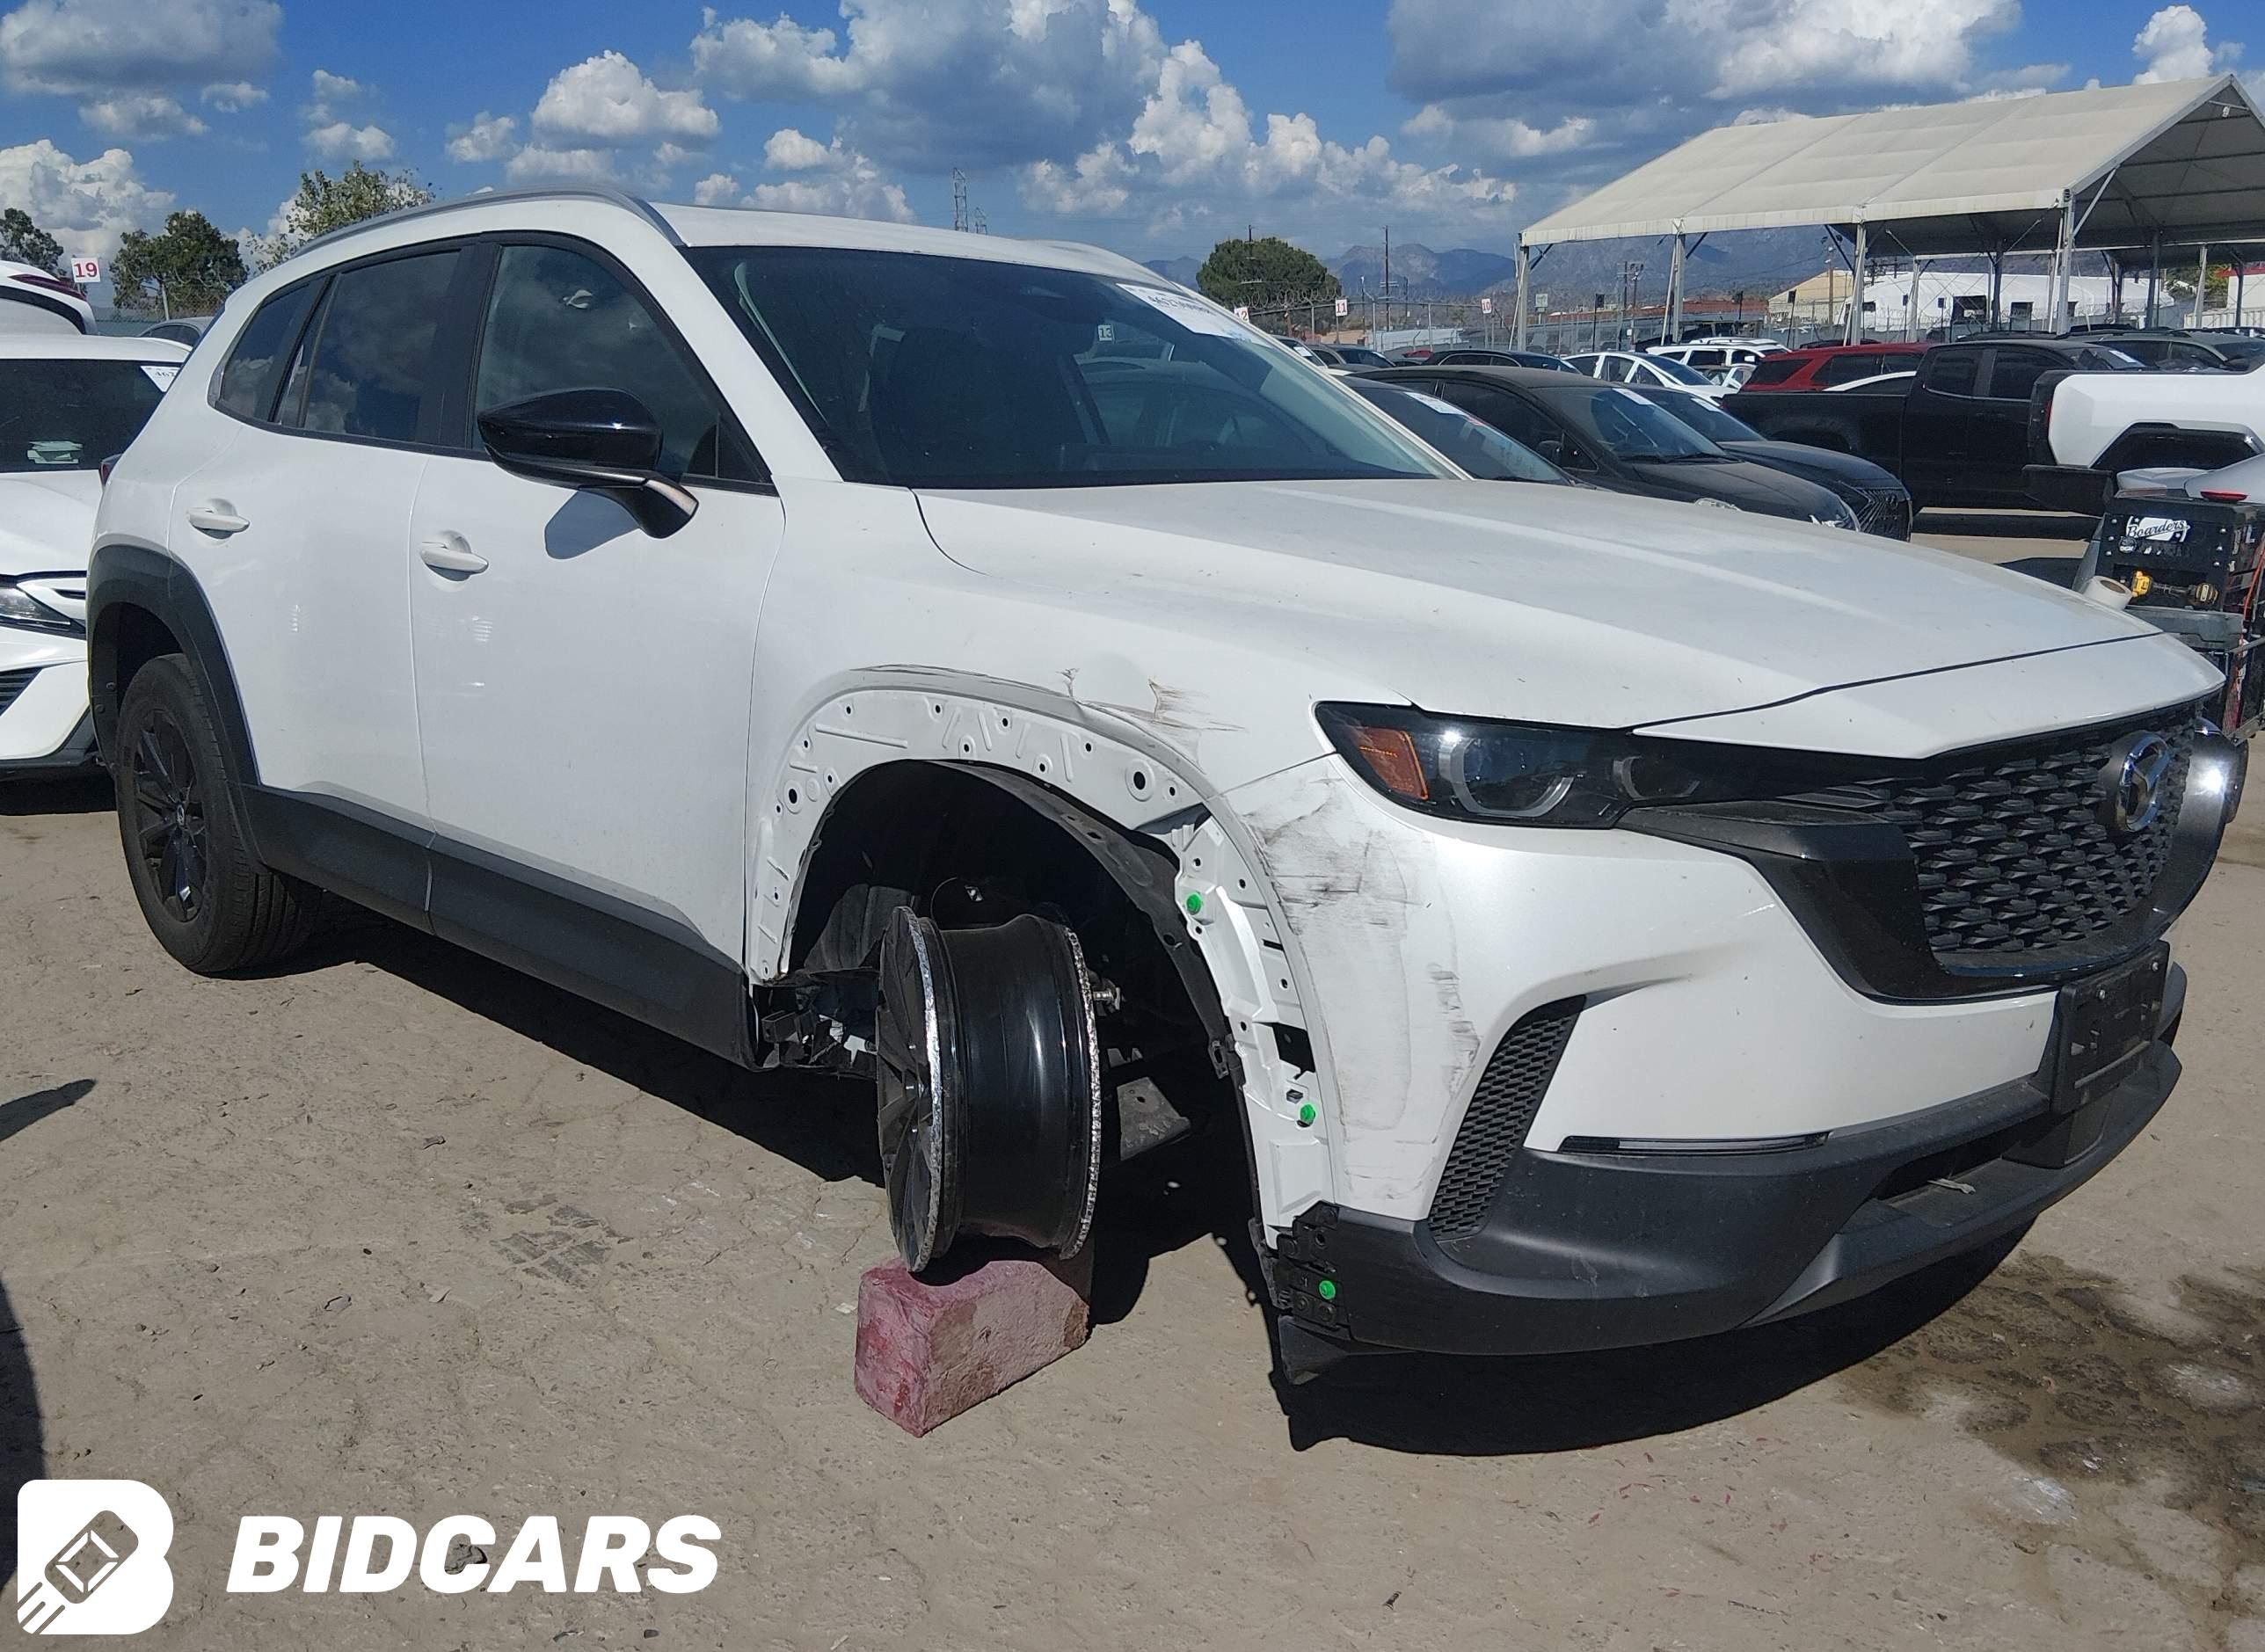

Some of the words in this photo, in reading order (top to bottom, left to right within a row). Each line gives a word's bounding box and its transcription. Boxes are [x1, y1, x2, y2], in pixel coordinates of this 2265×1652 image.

[74, 262, 98, 278] 19
[1336, 302, 1346, 313] 11
[1482, 302, 1490, 311] 10
[1099, 328, 1112, 338] 13
[2127, 520, 2186, 538] Boarders
